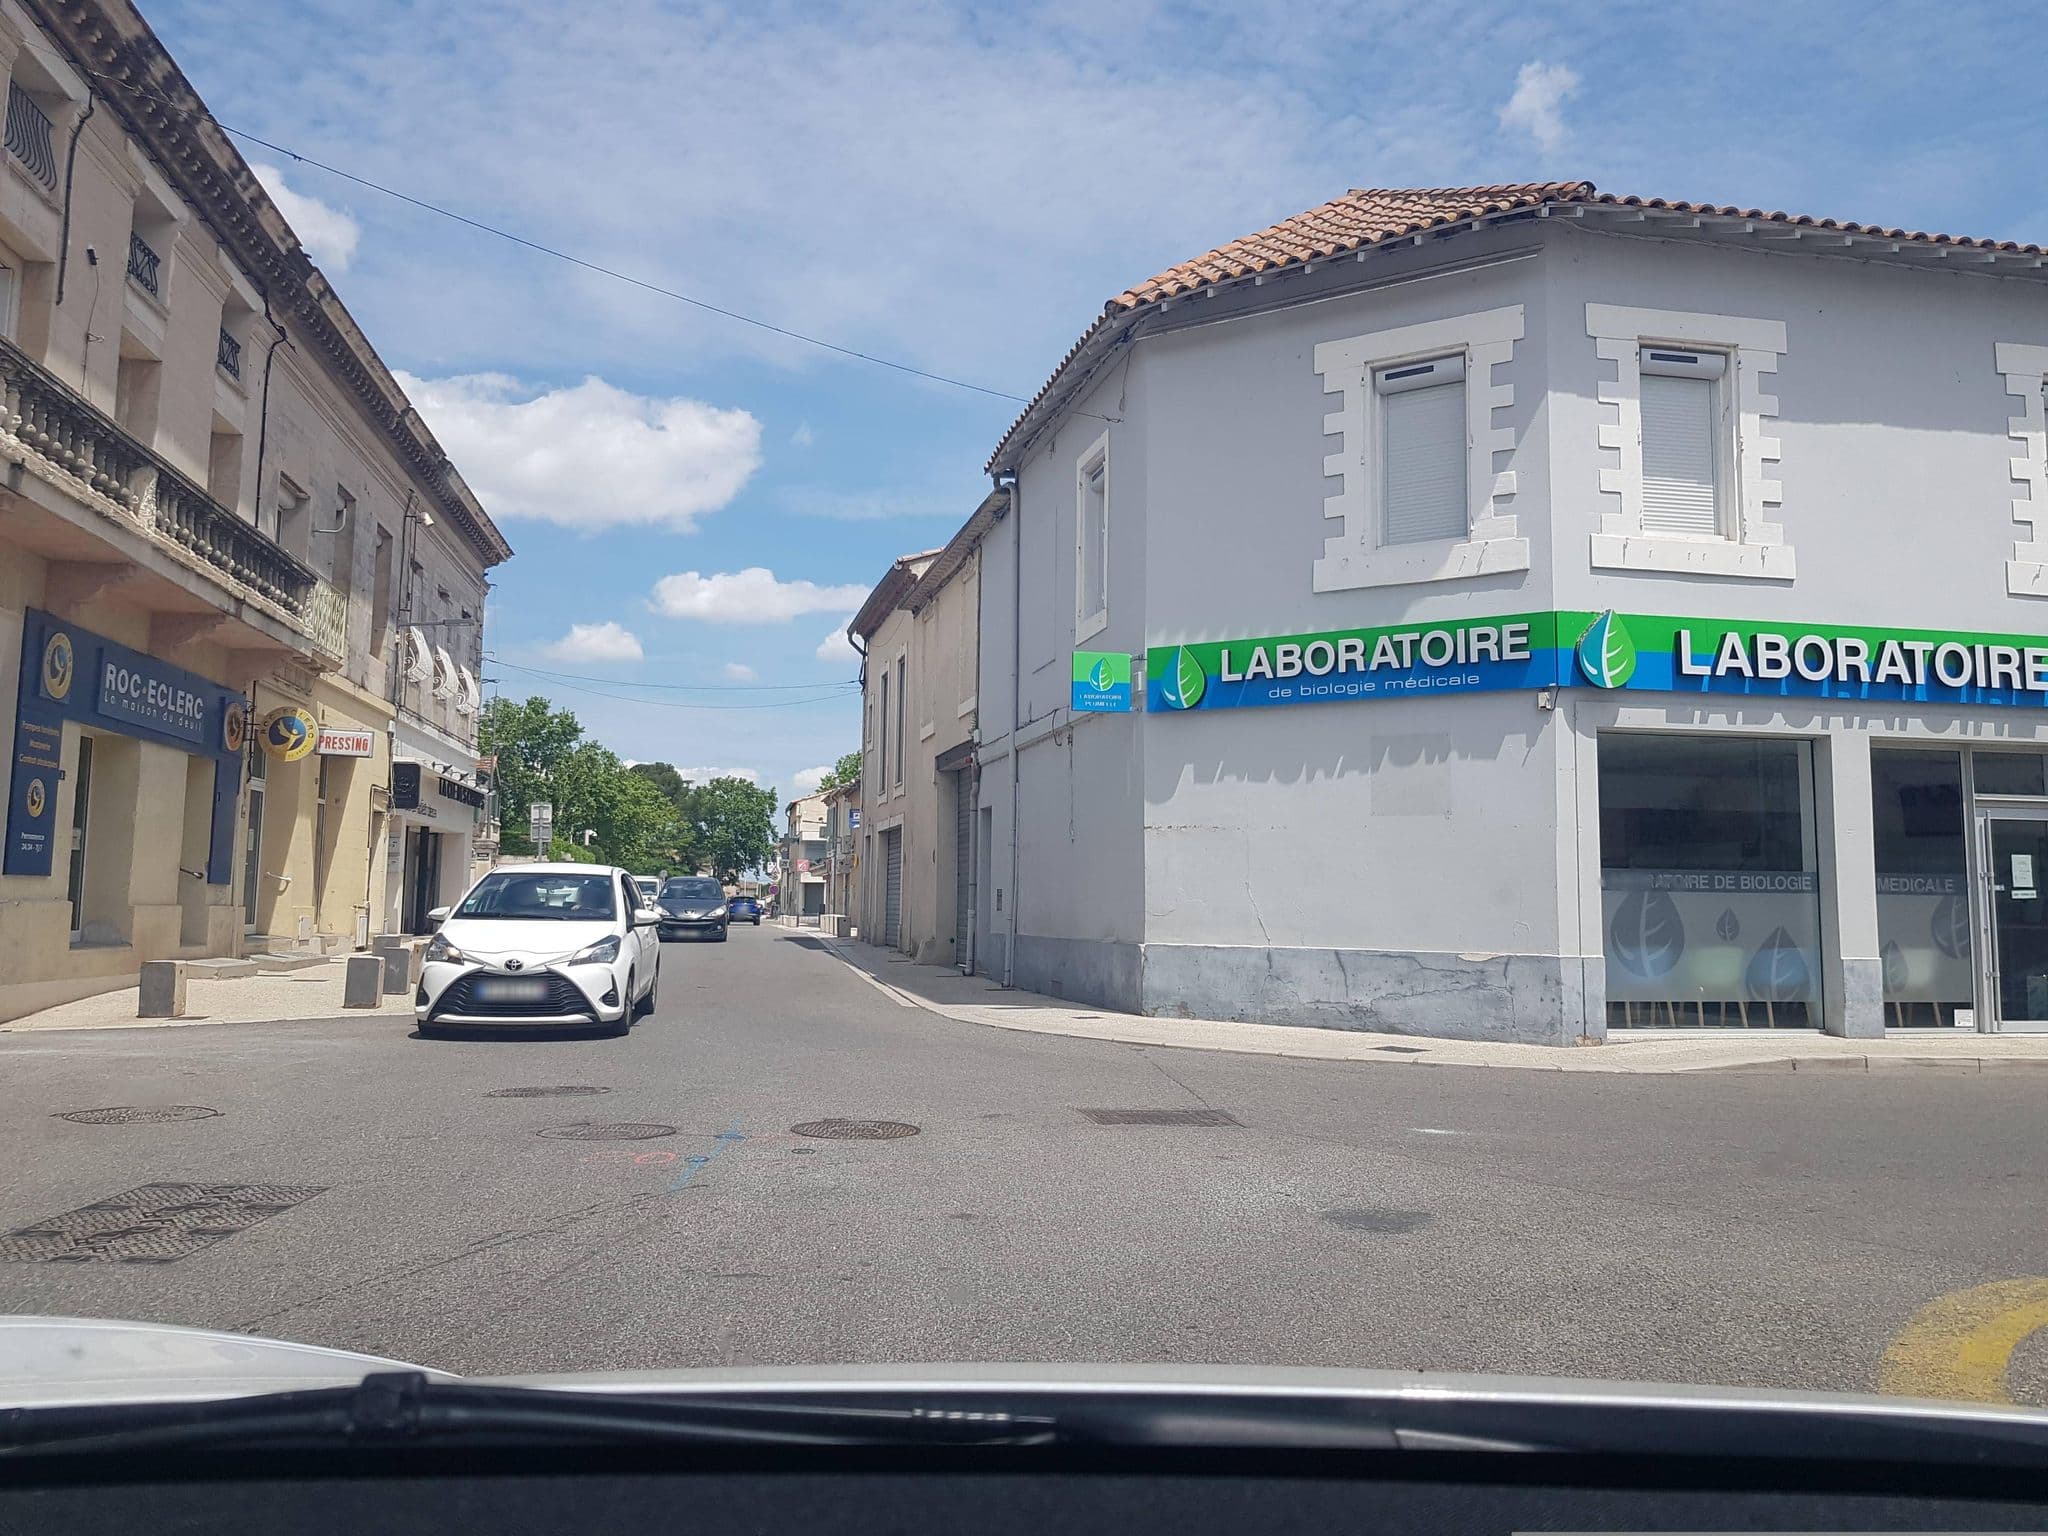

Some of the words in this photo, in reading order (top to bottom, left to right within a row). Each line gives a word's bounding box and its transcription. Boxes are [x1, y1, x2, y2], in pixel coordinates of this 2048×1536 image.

[1221, 623, 1530, 682] LABORATOIRE
[1679, 629, 2048, 691] LABORATOIRE
[147, 679, 204, 720] ECLERC
[1268, 687, 1292, 699] de
[1300, 680, 1376, 697] biologie
[1385, 673, 1480, 690] médicale
[122, 699, 157, 718] maison
[163, 711, 175, 723] du
[178, 716, 202, 732] deuil
[318, 735, 369, 752] PRESSING
[1714, 874, 1736, 889] DE
[1740, 875, 1812, 890] BIOLOGIE
[1877, 877, 1954, 892] MEDICALE
